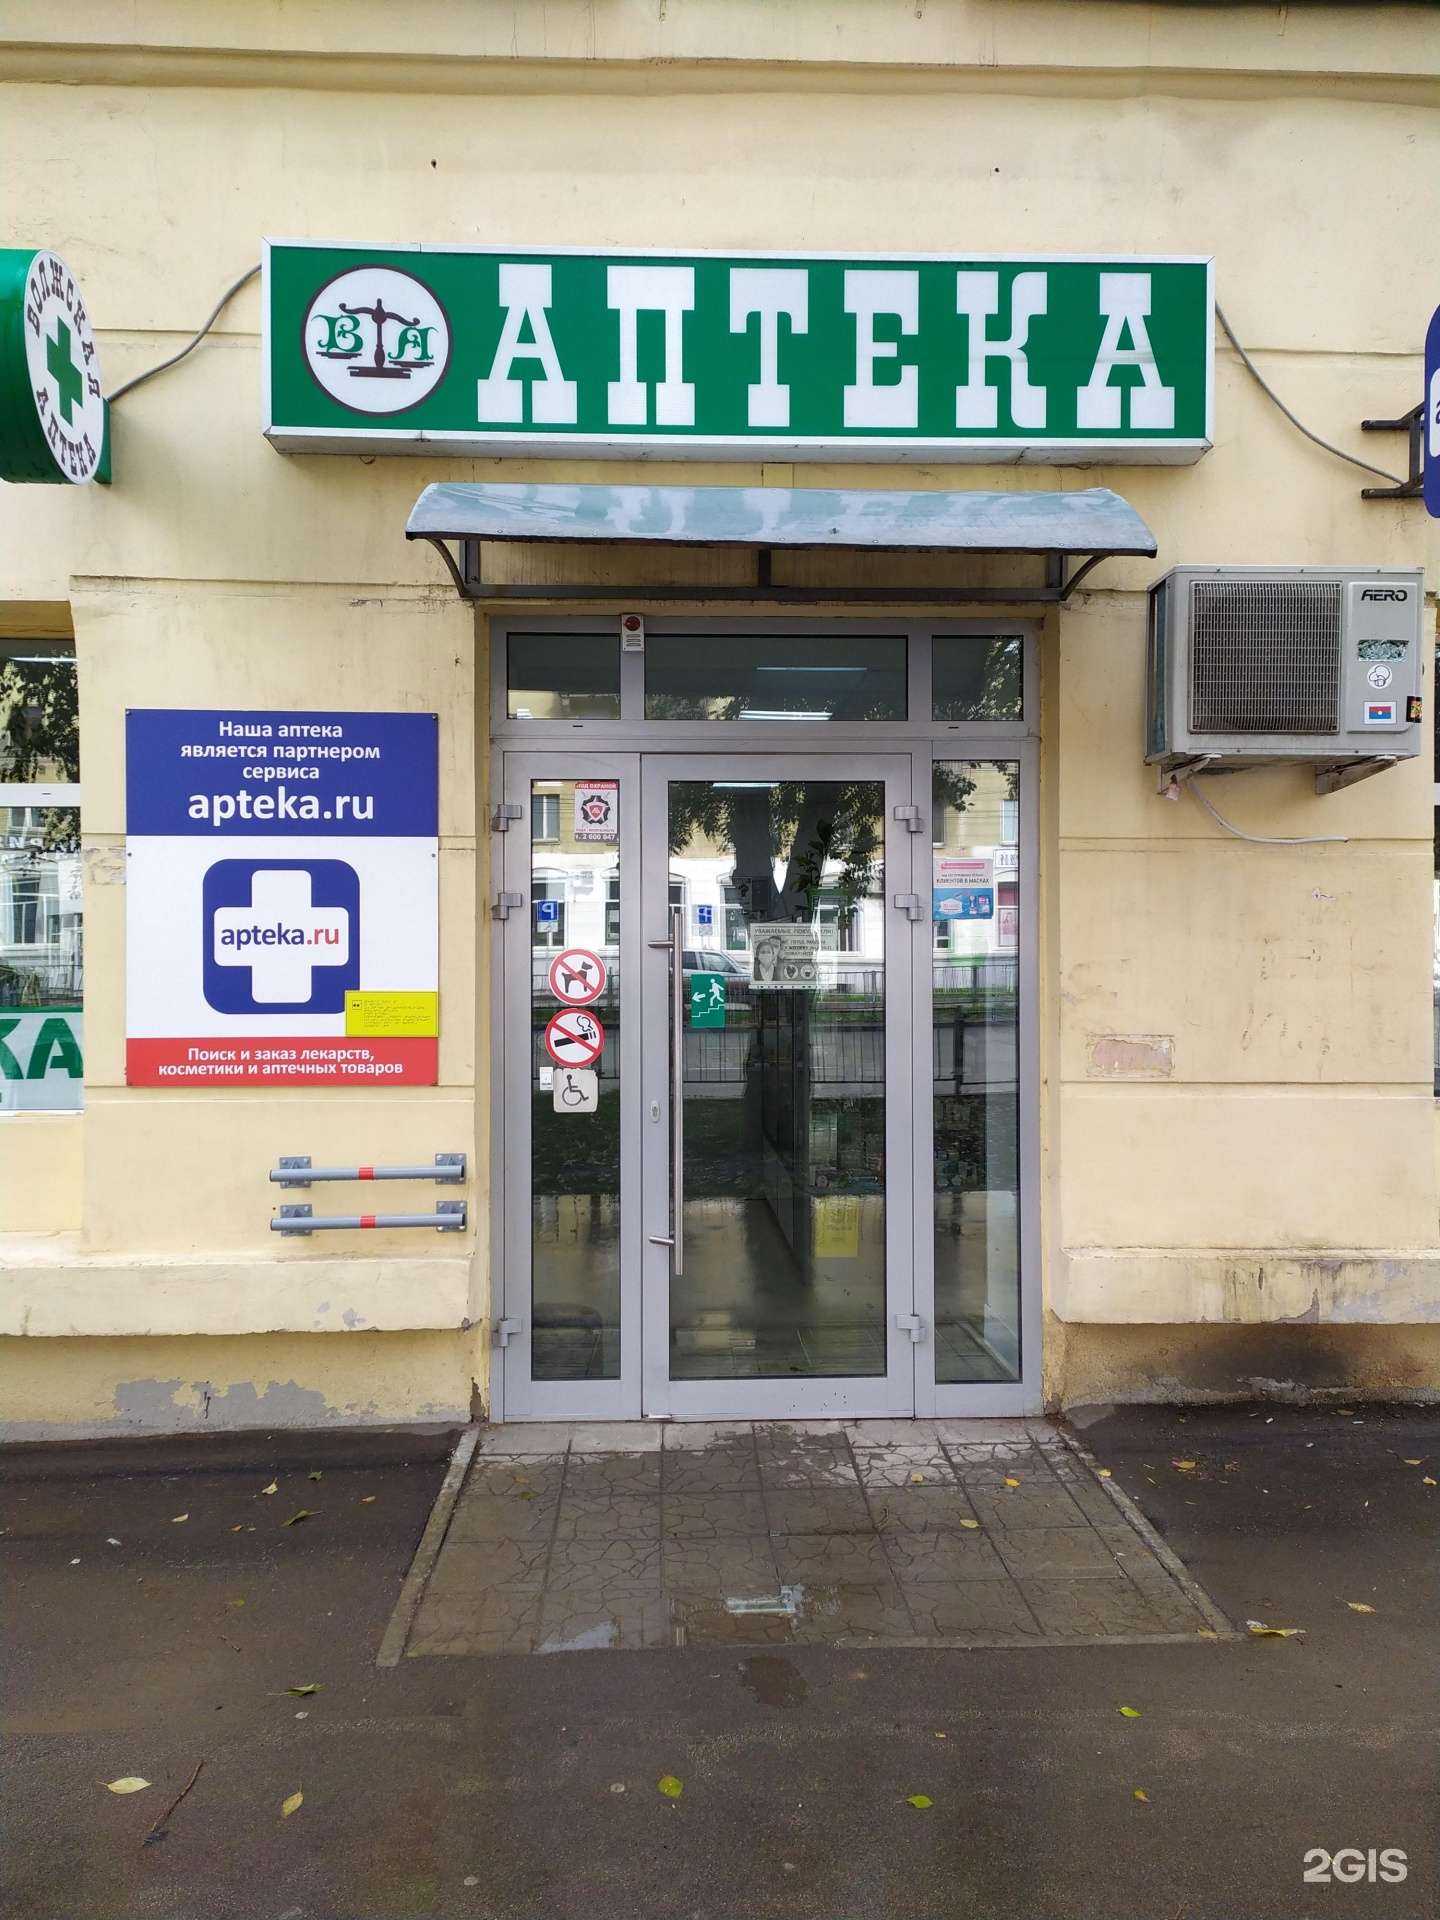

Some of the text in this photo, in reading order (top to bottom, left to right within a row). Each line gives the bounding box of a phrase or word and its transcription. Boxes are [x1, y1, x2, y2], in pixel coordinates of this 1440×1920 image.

[27, 258, 101, 398] ВОЛЖСКАЯ
[477, 263, 1175, 429] АПТЕКА
[36, 387, 96, 478] АПТЕКА
[1361, 589, 1408, 601] AERO
[219, 721, 343, 738] Наша аптека
[180, 744, 381, 762] является партнером
[242, 765, 319, 782] сервиса
[188, 786, 374, 826] apteka.ru
[221, 922, 339, 950] apteka.ru
[188, 1048, 374, 1062] Поиск и заказ лекарств,
[158, 1063, 403, 1076] косметики и аптечных товаров
